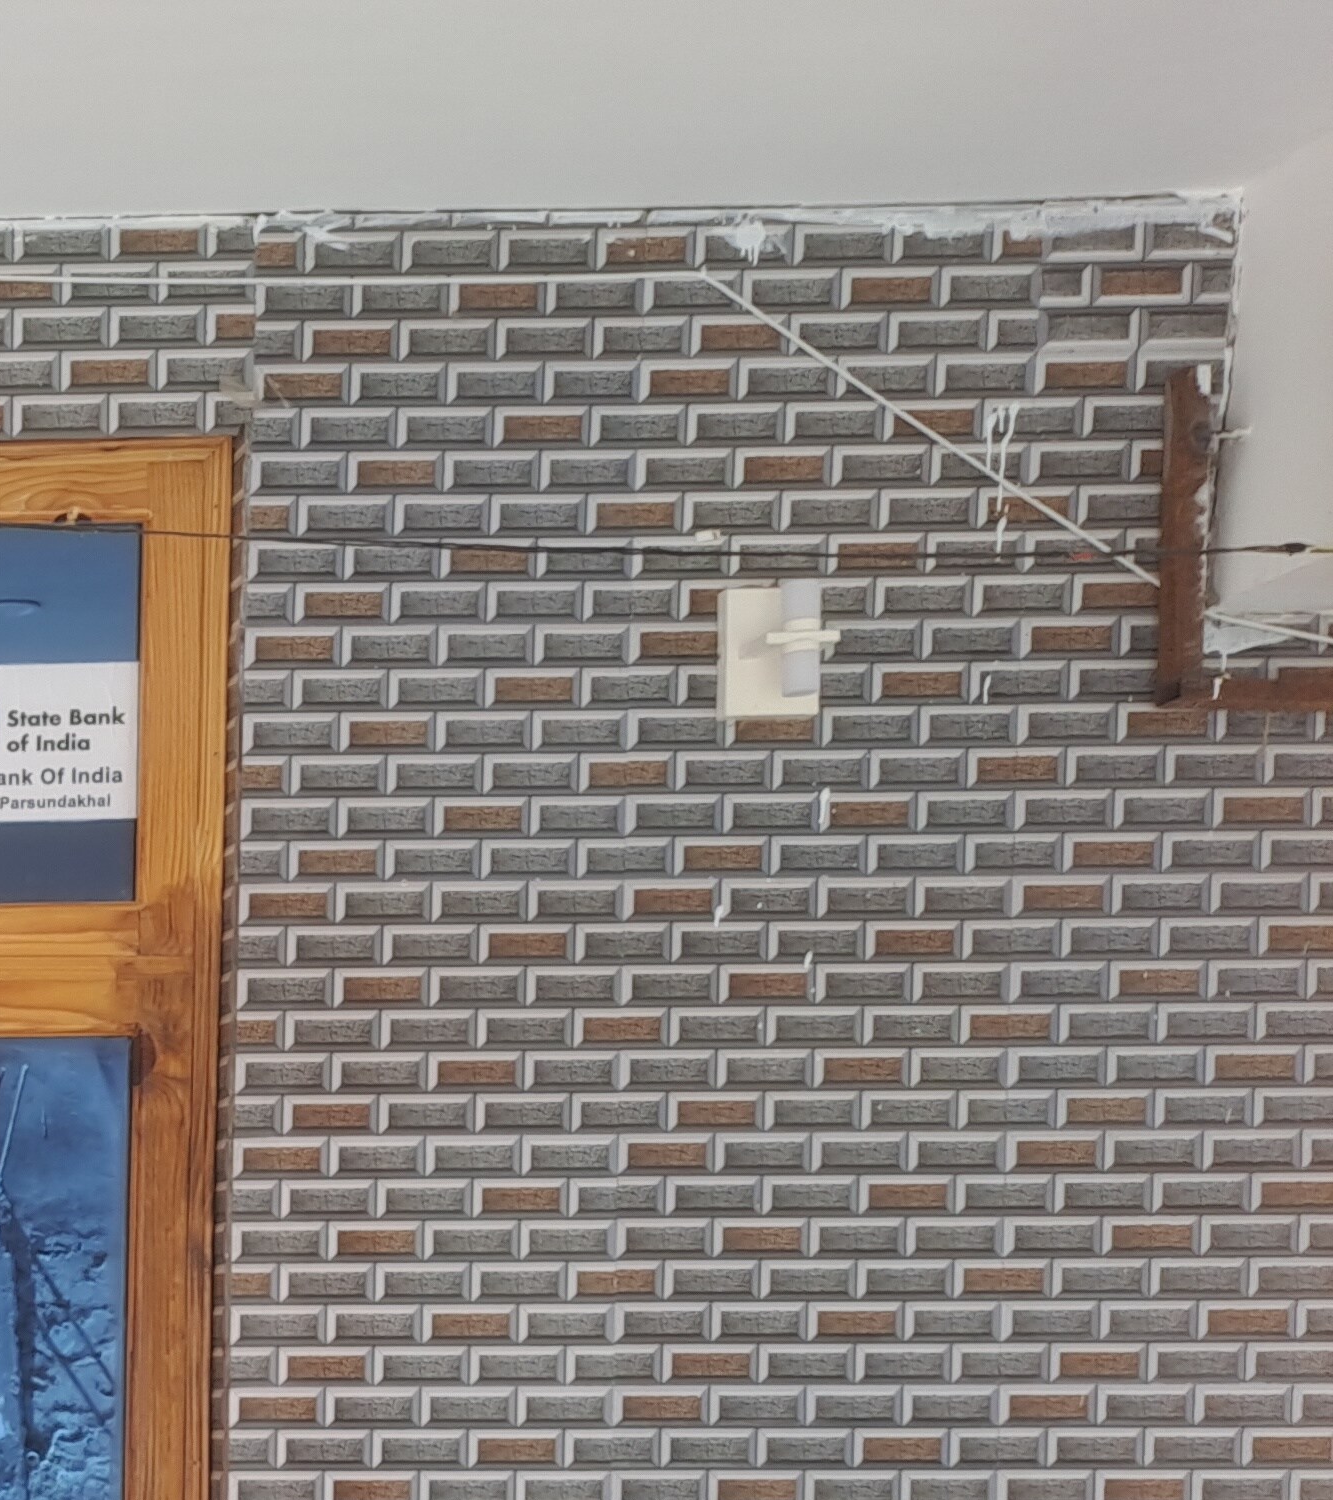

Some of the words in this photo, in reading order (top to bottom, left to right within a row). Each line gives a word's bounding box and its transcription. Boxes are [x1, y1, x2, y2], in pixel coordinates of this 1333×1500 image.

[7, 710, 61, 727] State
[69, 706, 125, 725] Bank
[7, 733, 29, 752] of
[36, 733, 90, 751] India
[41, 767, 65, 785] Of
[72, 767, 123, 784] India
[0, 793, 111, 810] Parsundakhal
